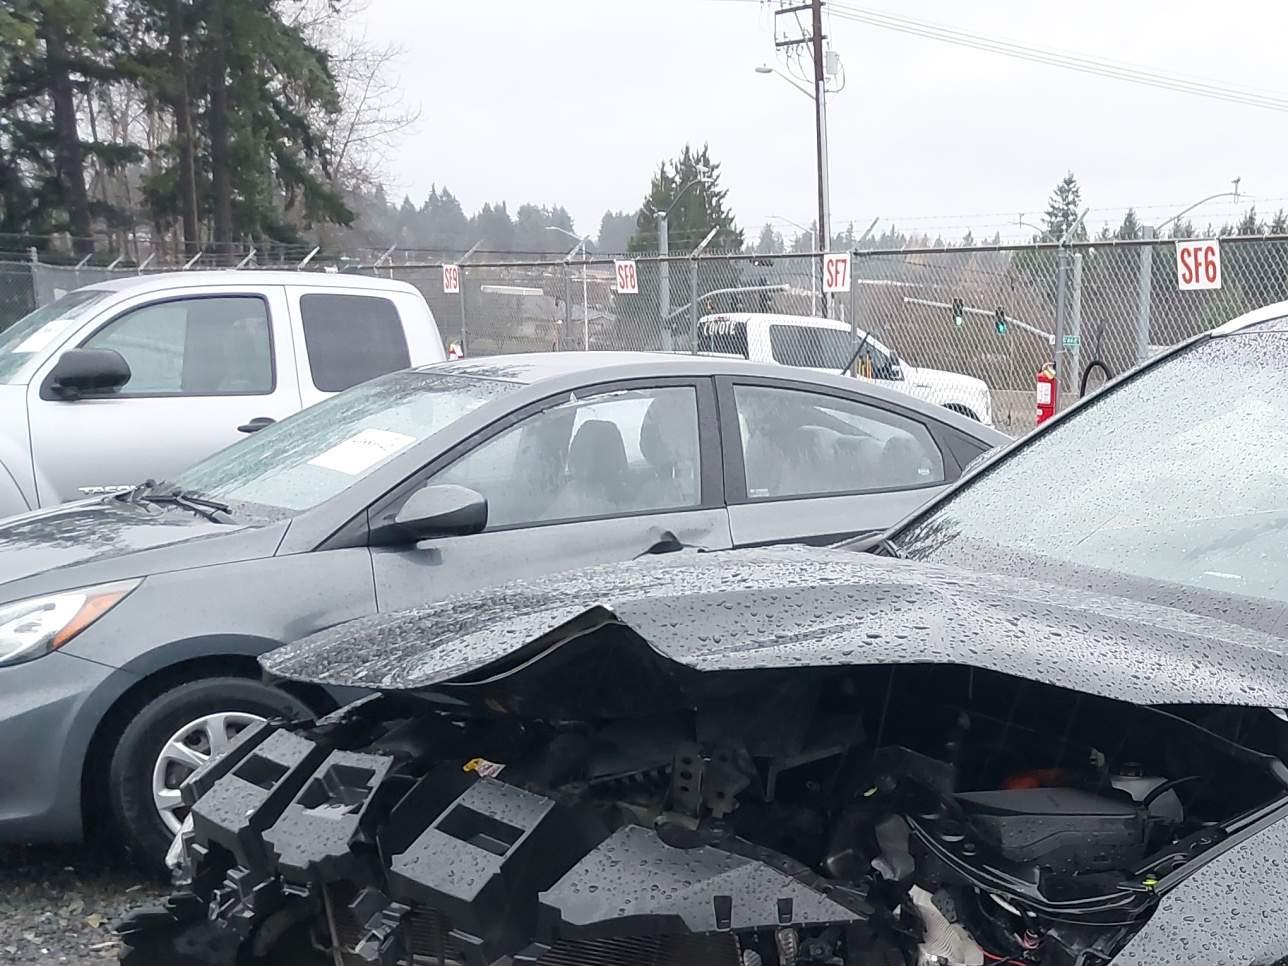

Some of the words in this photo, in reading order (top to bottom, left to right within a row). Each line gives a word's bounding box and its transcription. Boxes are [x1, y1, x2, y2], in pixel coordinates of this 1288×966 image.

[617, 264, 636, 289] SF8
[827, 259, 847, 288] SF7
[1181, 246, 1217, 284] SF6
[445, 267, 458, 289] SF9
[704, 320, 737, 336] COYOTE
